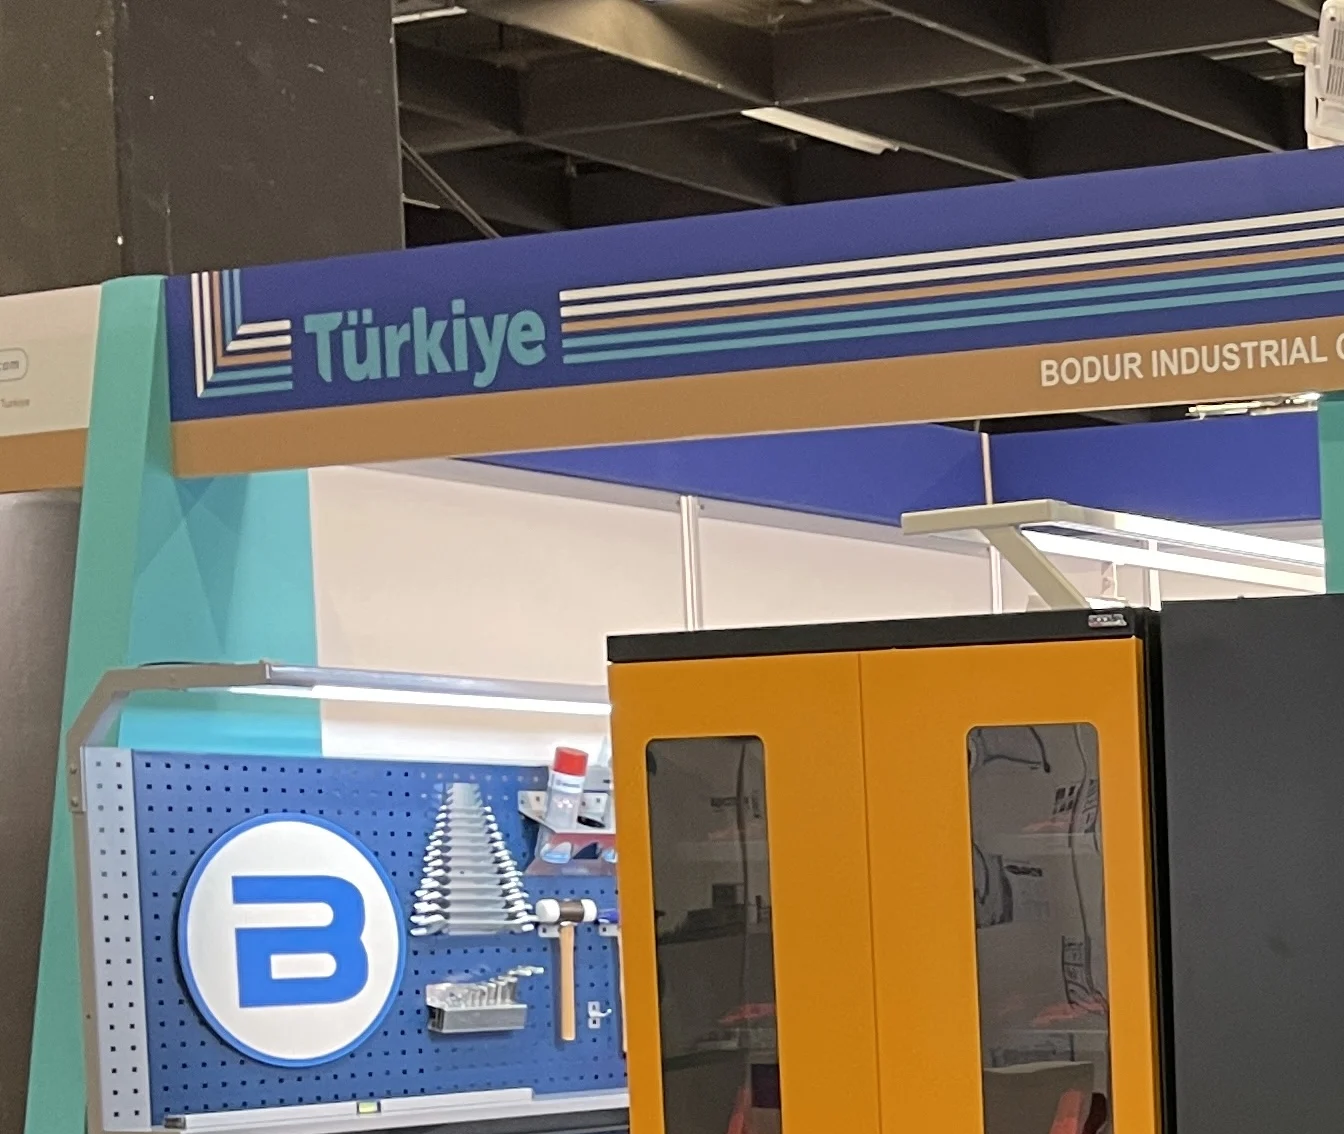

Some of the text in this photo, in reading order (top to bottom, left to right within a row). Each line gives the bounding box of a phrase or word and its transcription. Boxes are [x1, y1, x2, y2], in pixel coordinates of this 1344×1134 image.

[304, 298, 547, 388] Türkiye
[1040, 353, 1143, 388] BODUR
[1151, 336, 1328, 379] INDUSTRIAL
